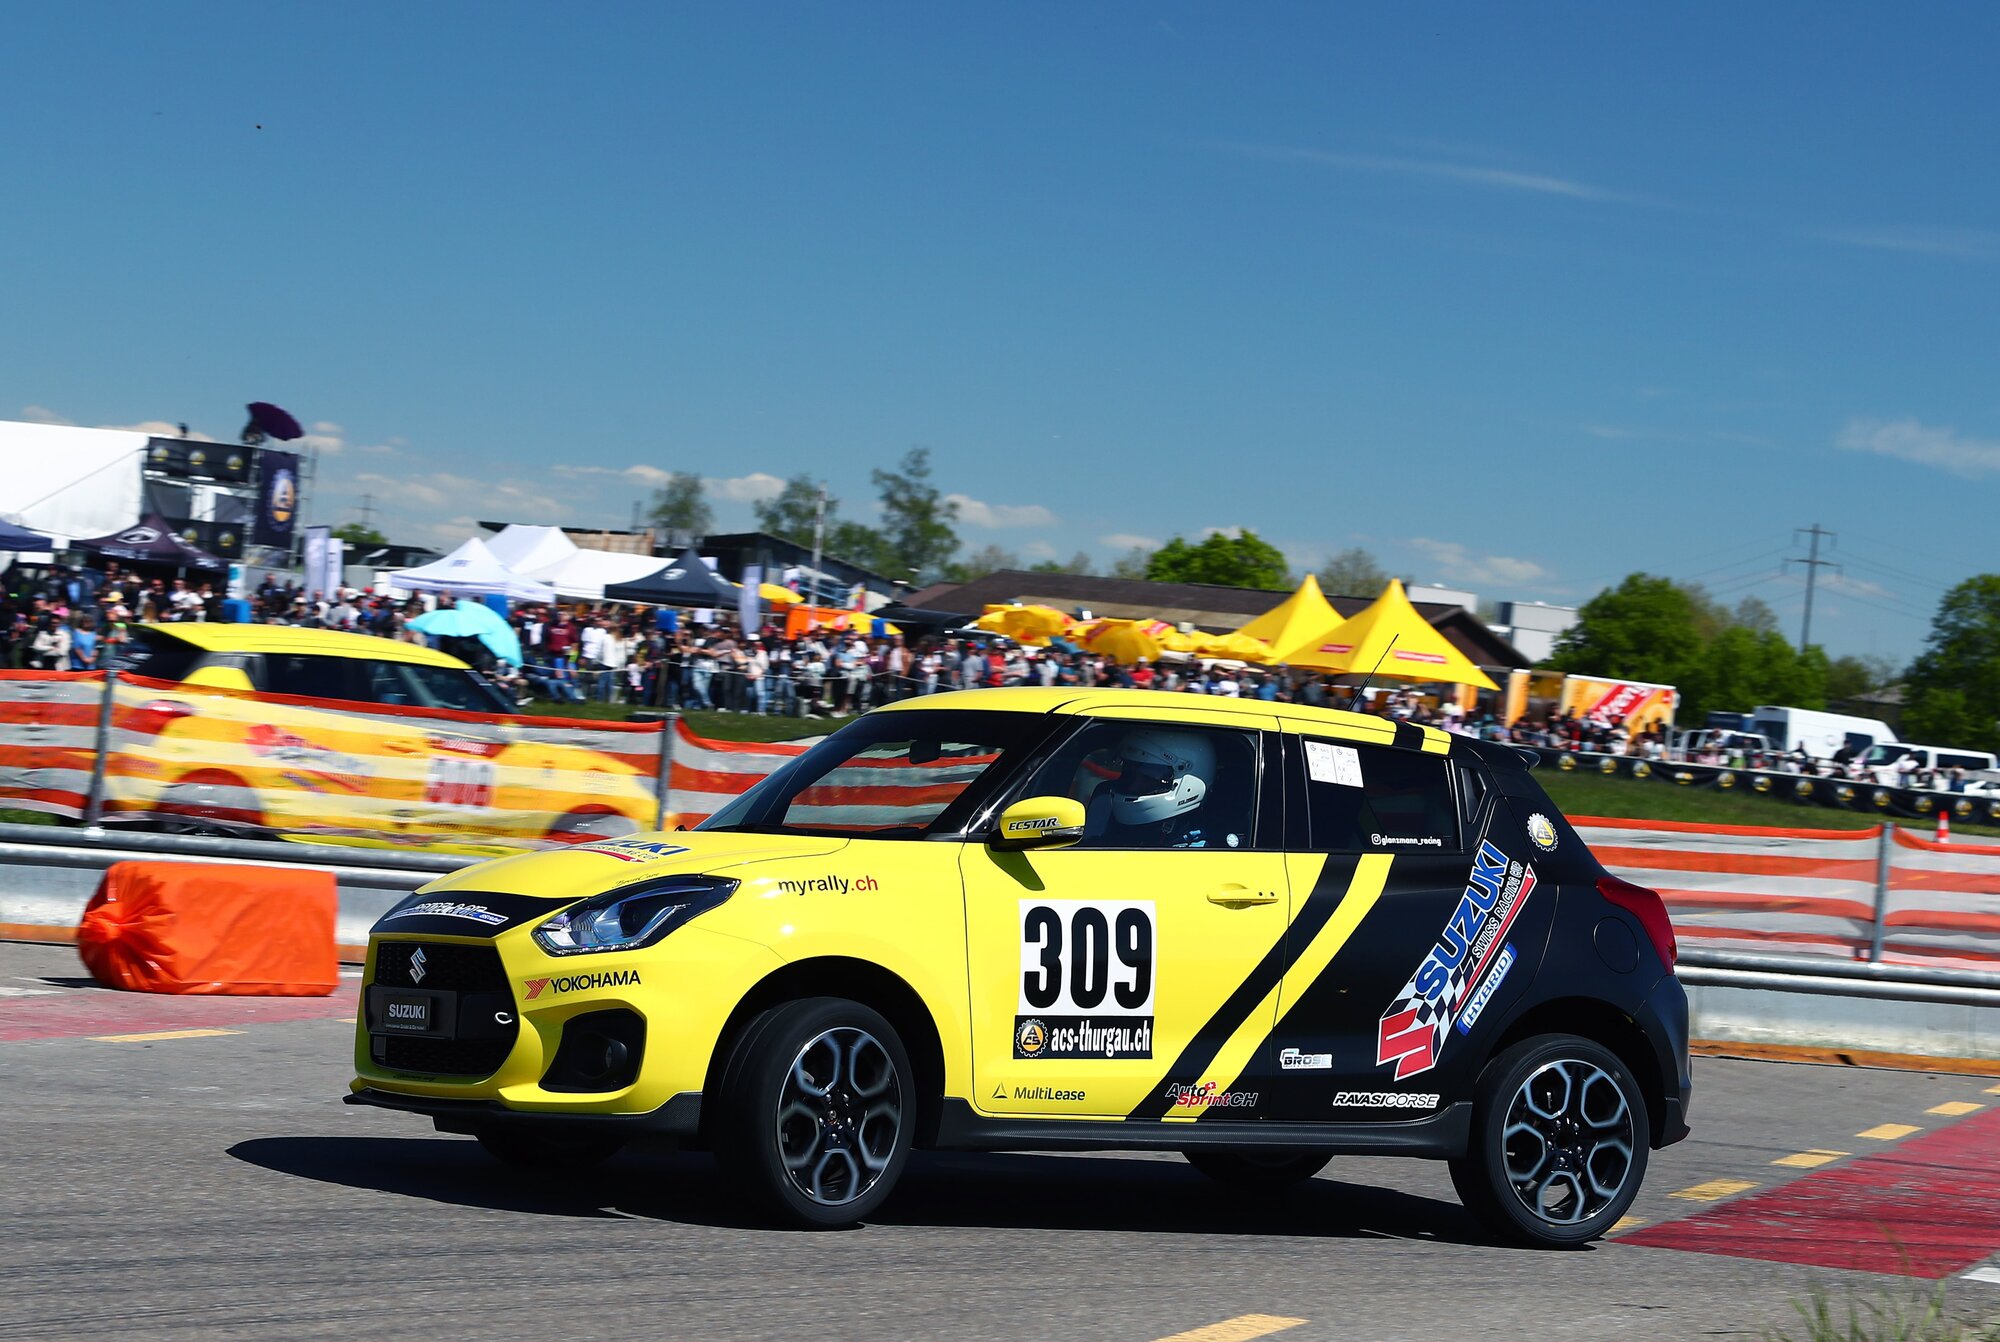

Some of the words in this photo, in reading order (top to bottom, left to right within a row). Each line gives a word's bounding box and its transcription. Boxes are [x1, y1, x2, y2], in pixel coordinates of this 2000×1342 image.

[1008, 817, 1058, 831] ECSTAR
[778, 875, 879, 896] myrally.ch
[1415, 838, 1509, 1001] SUZUKI
[1472, 917, 1500, 958] SWISS
[1494, 876, 1521, 920] RACING
[1509, 861, 1524, 878] CUP
[1024, 906, 1152, 1009] 309
[551, 970, 641, 994] YOKOHAMA
[1467, 957, 1509, 1022] HYBRID
[388, 1003, 426, 1019] SUZUKI
[1050, 1019, 1151, 1058] acs-thurgau.ch
[1013, 1086, 1086, 1101] MultiLease
[1164, 1082, 1209, 1098] Auto
[1334, 1093, 1440, 1107] RAVASICORSE
[1176, 1093, 1259, 1109] SprintCH
